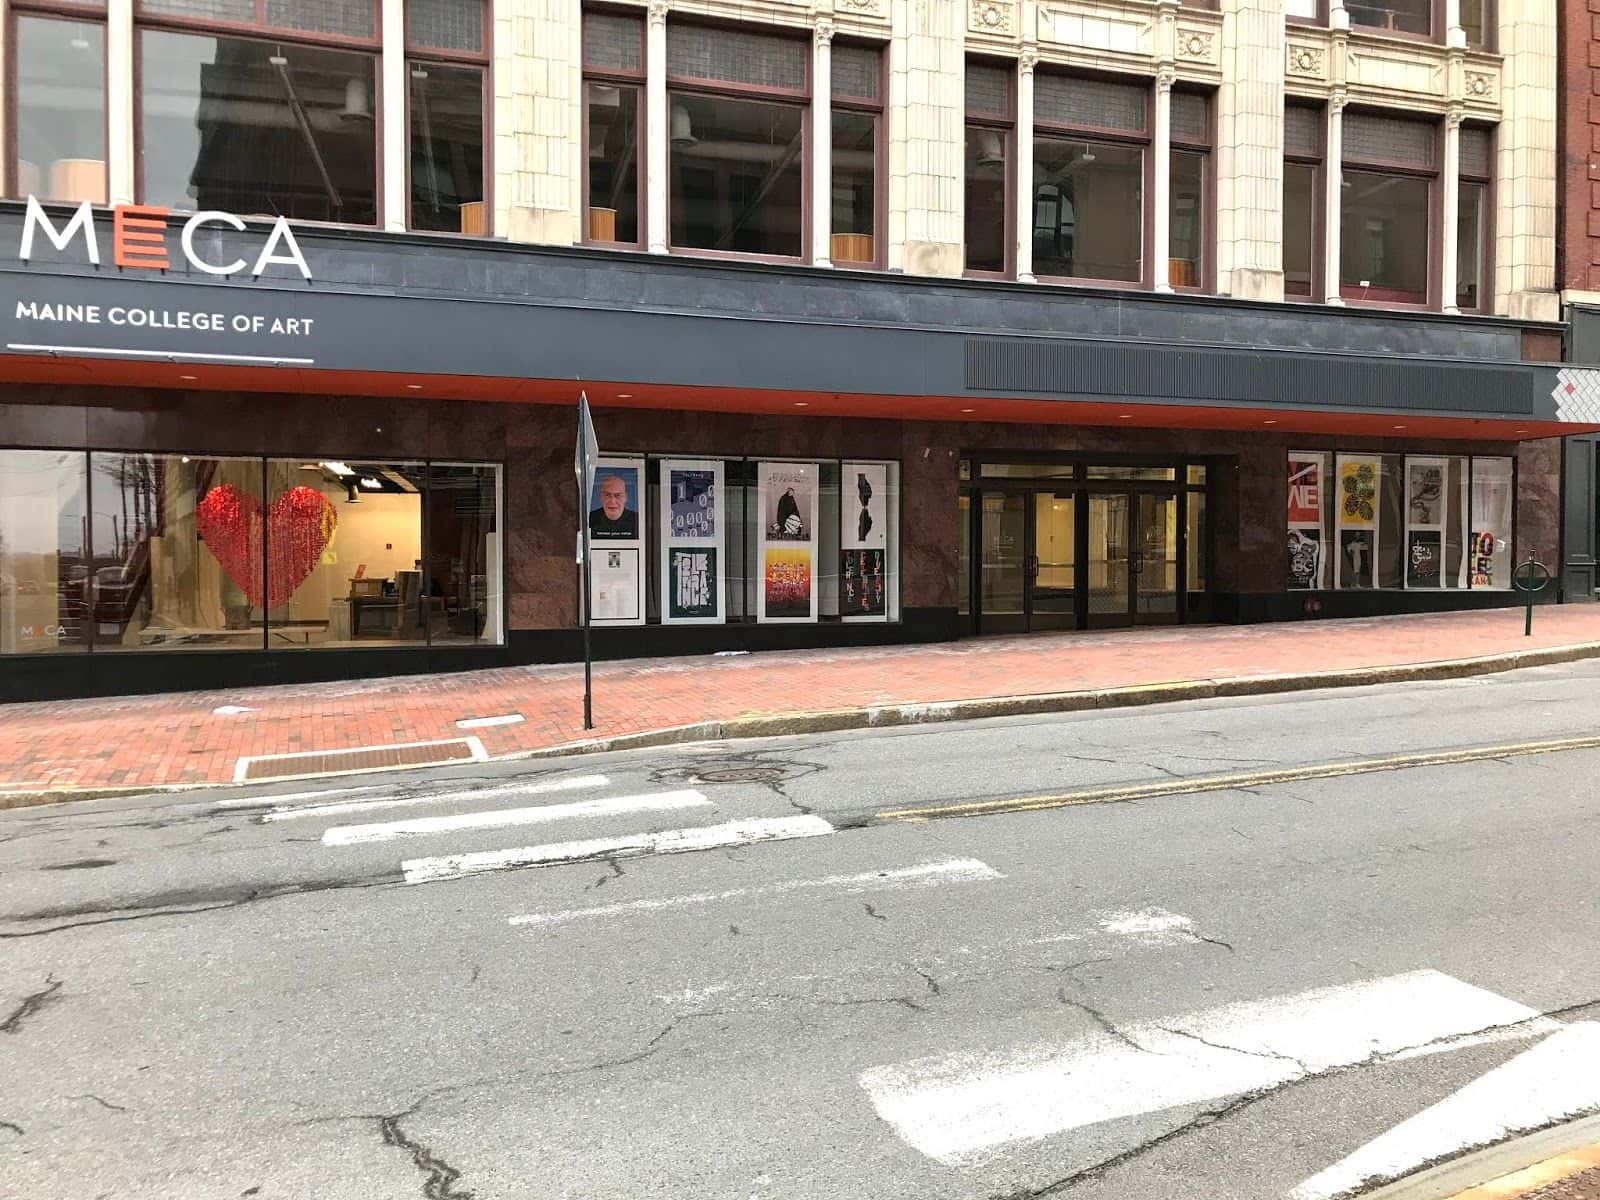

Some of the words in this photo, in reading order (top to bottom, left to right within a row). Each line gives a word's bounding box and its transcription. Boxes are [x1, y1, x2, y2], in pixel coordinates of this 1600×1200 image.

[19, 194, 313, 280] MECA
[15, 300, 101, 324] MAINE
[108, 306, 225, 332] COLLEGE
[232, 315, 264, 333] OF
[270, 317, 314, 336] ART
